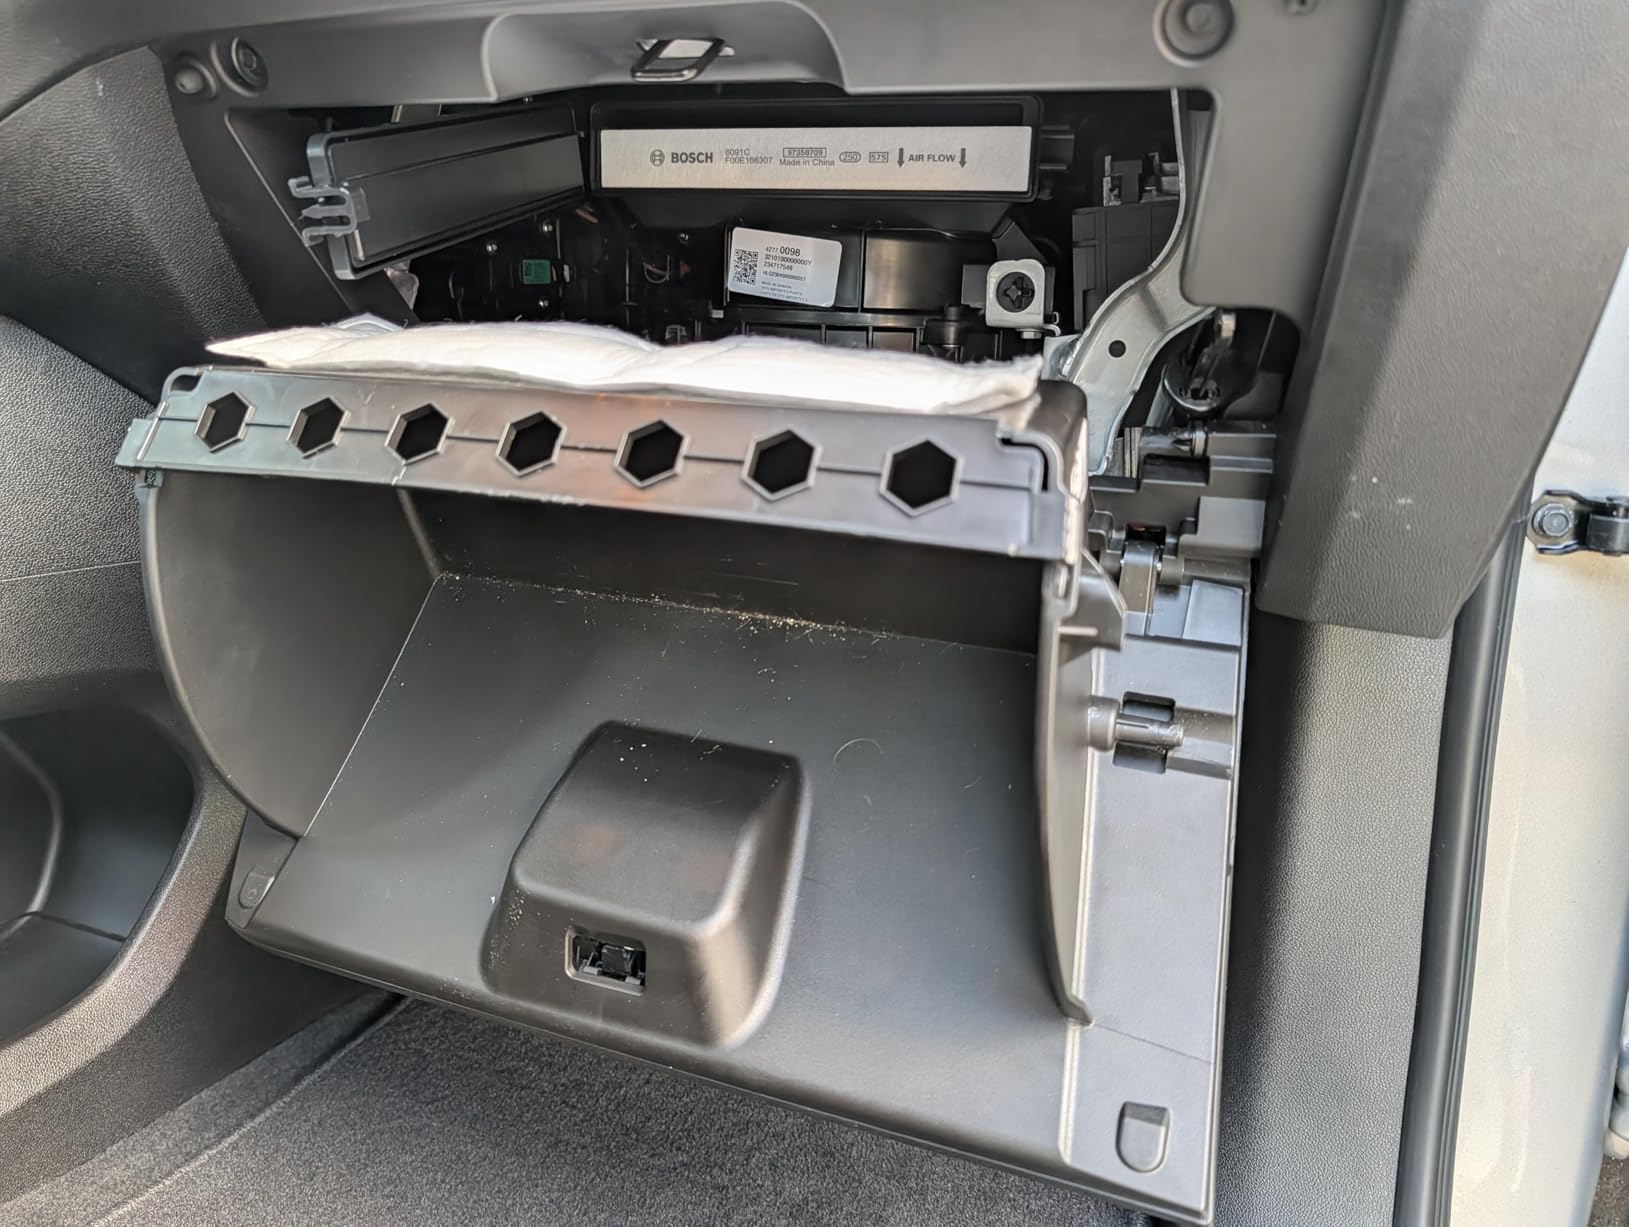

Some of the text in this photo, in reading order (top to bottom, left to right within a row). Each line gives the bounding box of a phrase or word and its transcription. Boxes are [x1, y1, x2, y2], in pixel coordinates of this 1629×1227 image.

[671, 152, 713, 164] BOSCH
[843, 153, 858, 161] 250
[871, 154, 887, 162] 575
[908, 154, 956, 163] AIR FLOW
[779, 158, 835, 167] Made in China
[780, 246, 801, 257] 0098
